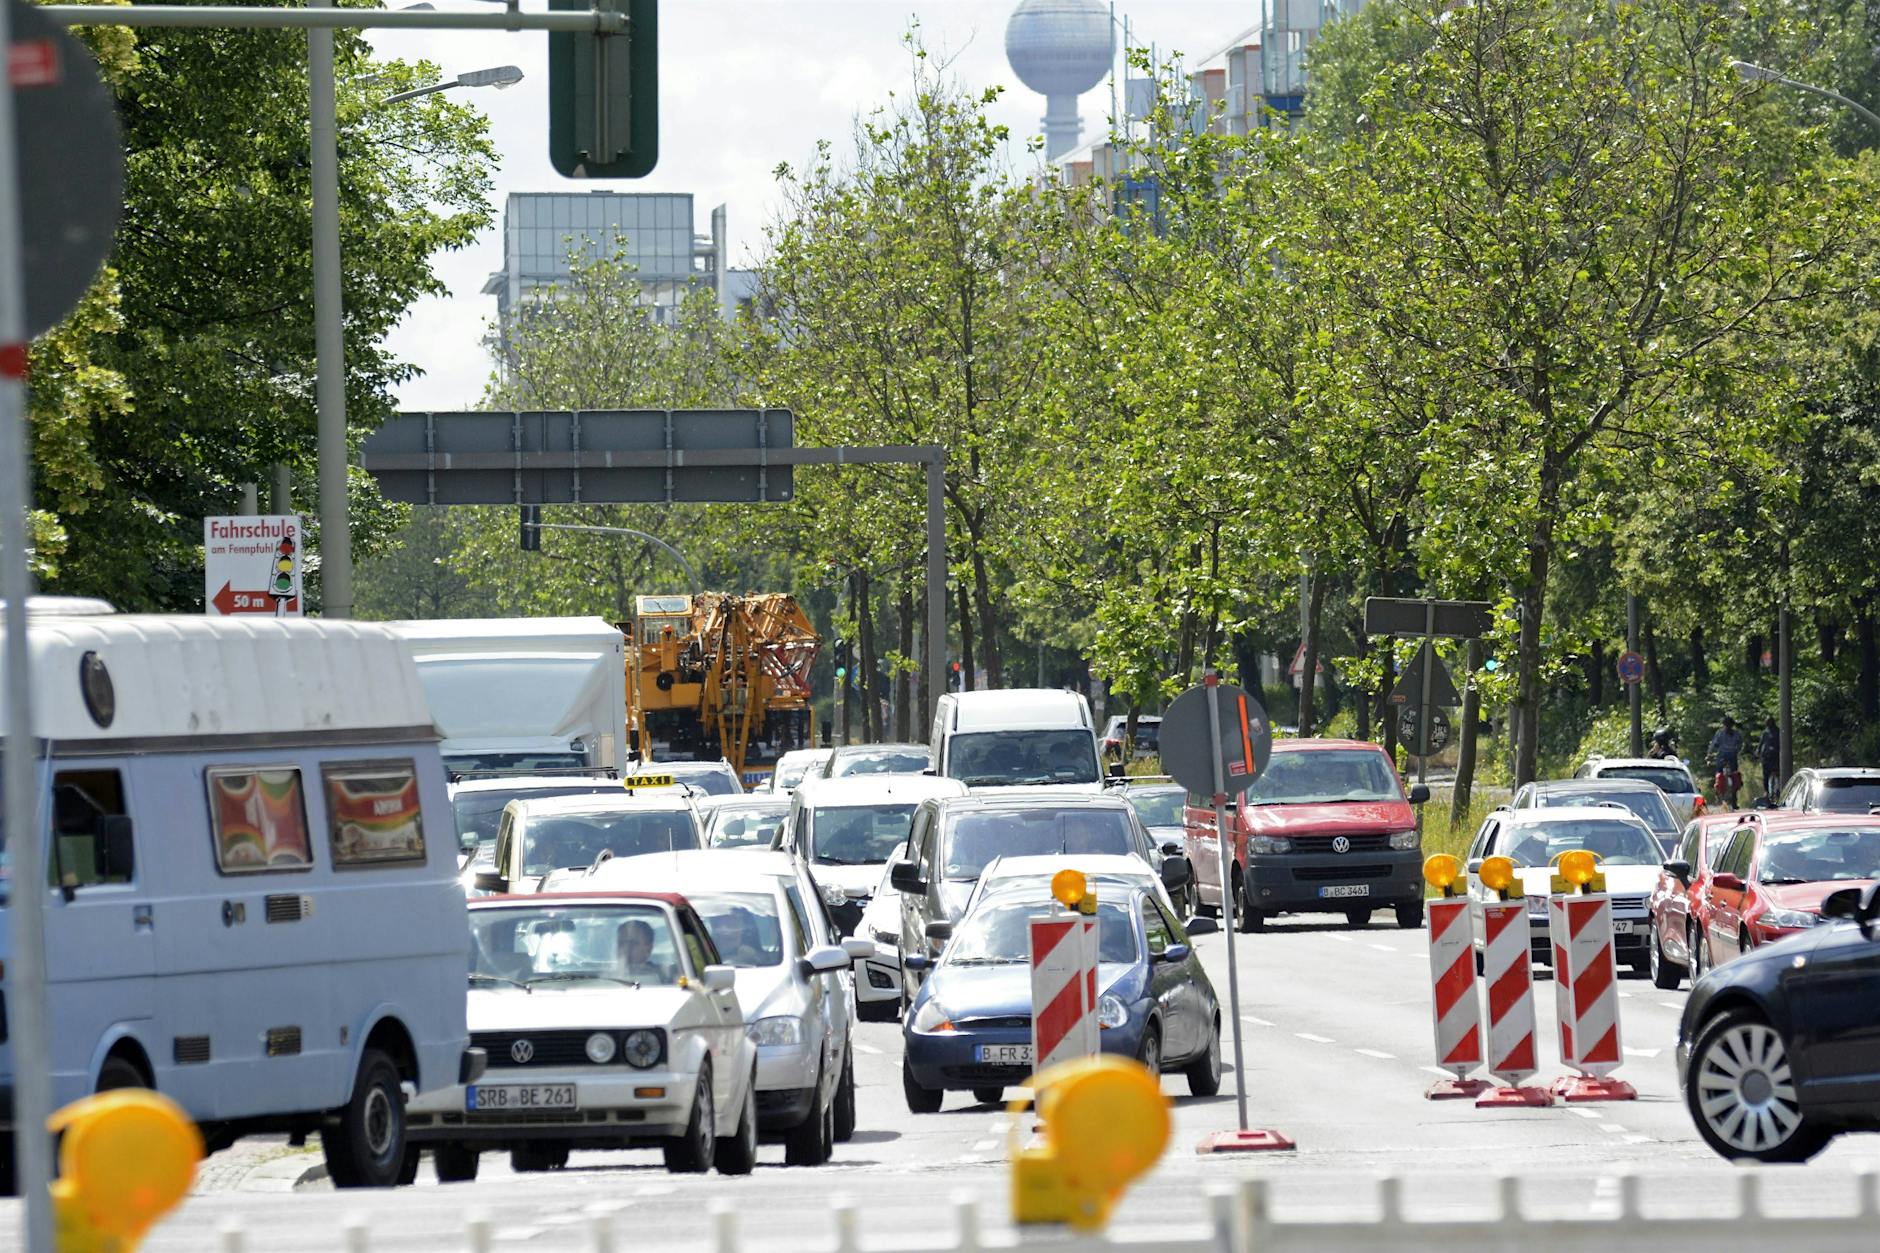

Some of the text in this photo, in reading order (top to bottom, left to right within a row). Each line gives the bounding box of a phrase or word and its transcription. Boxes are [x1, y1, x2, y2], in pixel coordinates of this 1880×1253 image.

[211, 519, 296, 539] Fahrschule
[211, 543, 274, 556] am Fennpfuhl
[233, 594, 265, 608] 50 m
[632, 776, 666, 786] TAXI
[1334, 887, 1346, 896] BC
[1612, 921, 1628, 932] 47
[982, 1046, 1032, 1060] B FR 3
[478, 1087, 573, 1107] SRB BE 261
